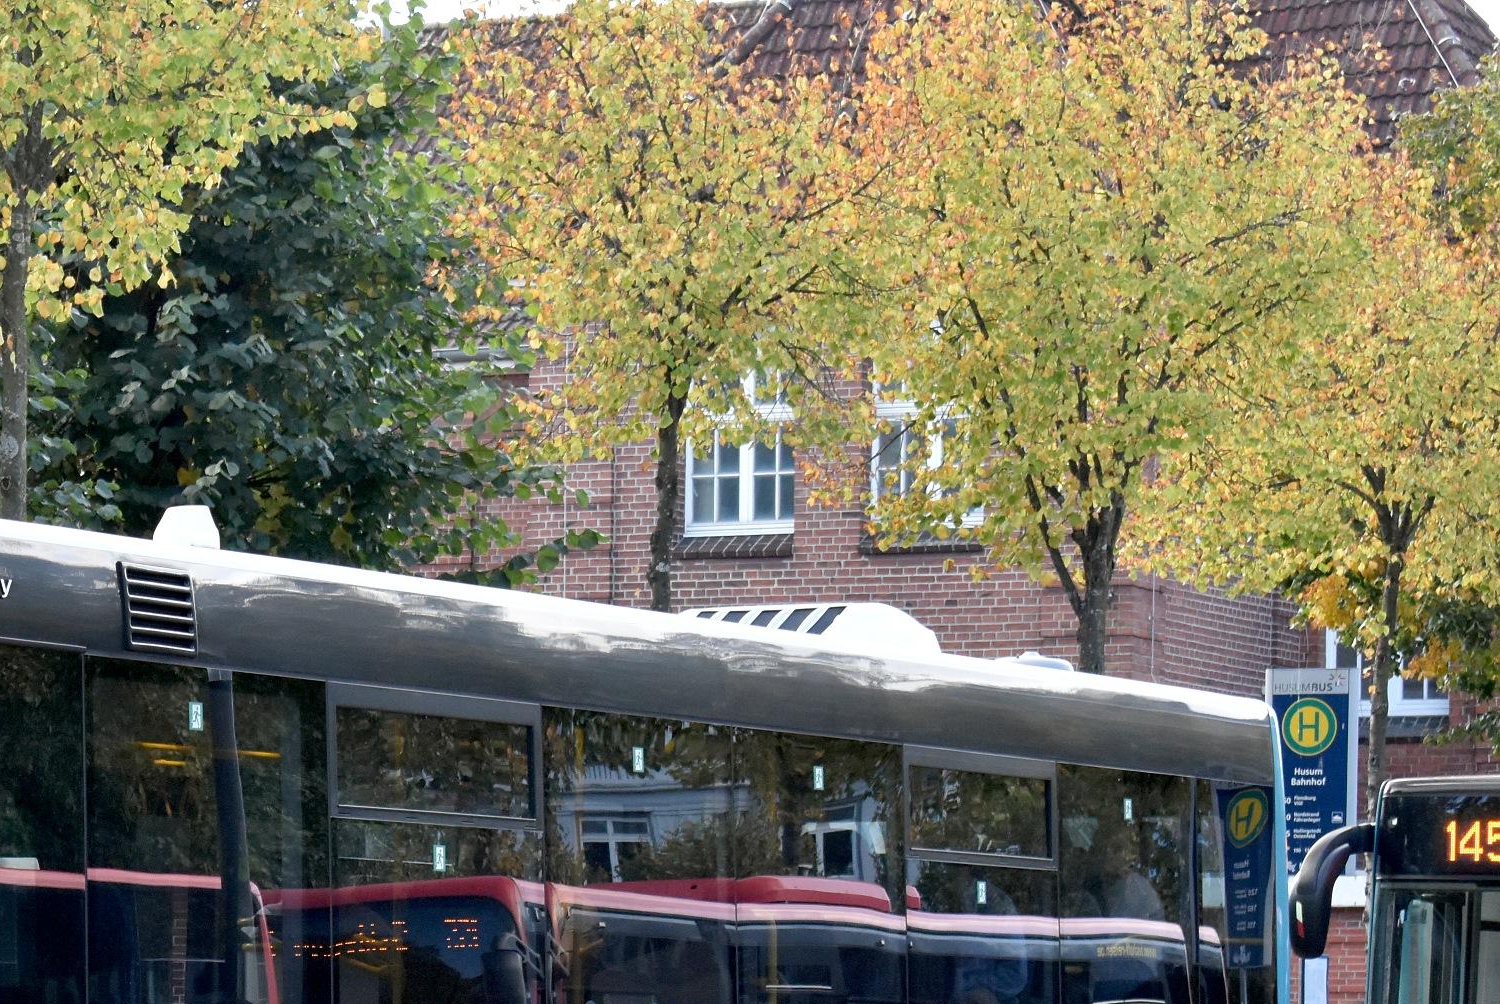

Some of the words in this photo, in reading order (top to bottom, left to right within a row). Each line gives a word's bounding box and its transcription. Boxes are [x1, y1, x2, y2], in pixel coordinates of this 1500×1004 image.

[1274, 682, 1333, 692] HUSUMBUS
[1298, 711, 1320, 742] H
[1294, 767, 1323, 776] Husum
[1291, 777, 1326, 786] Bahnhof
[1446, 820, 1500, 862] 145
